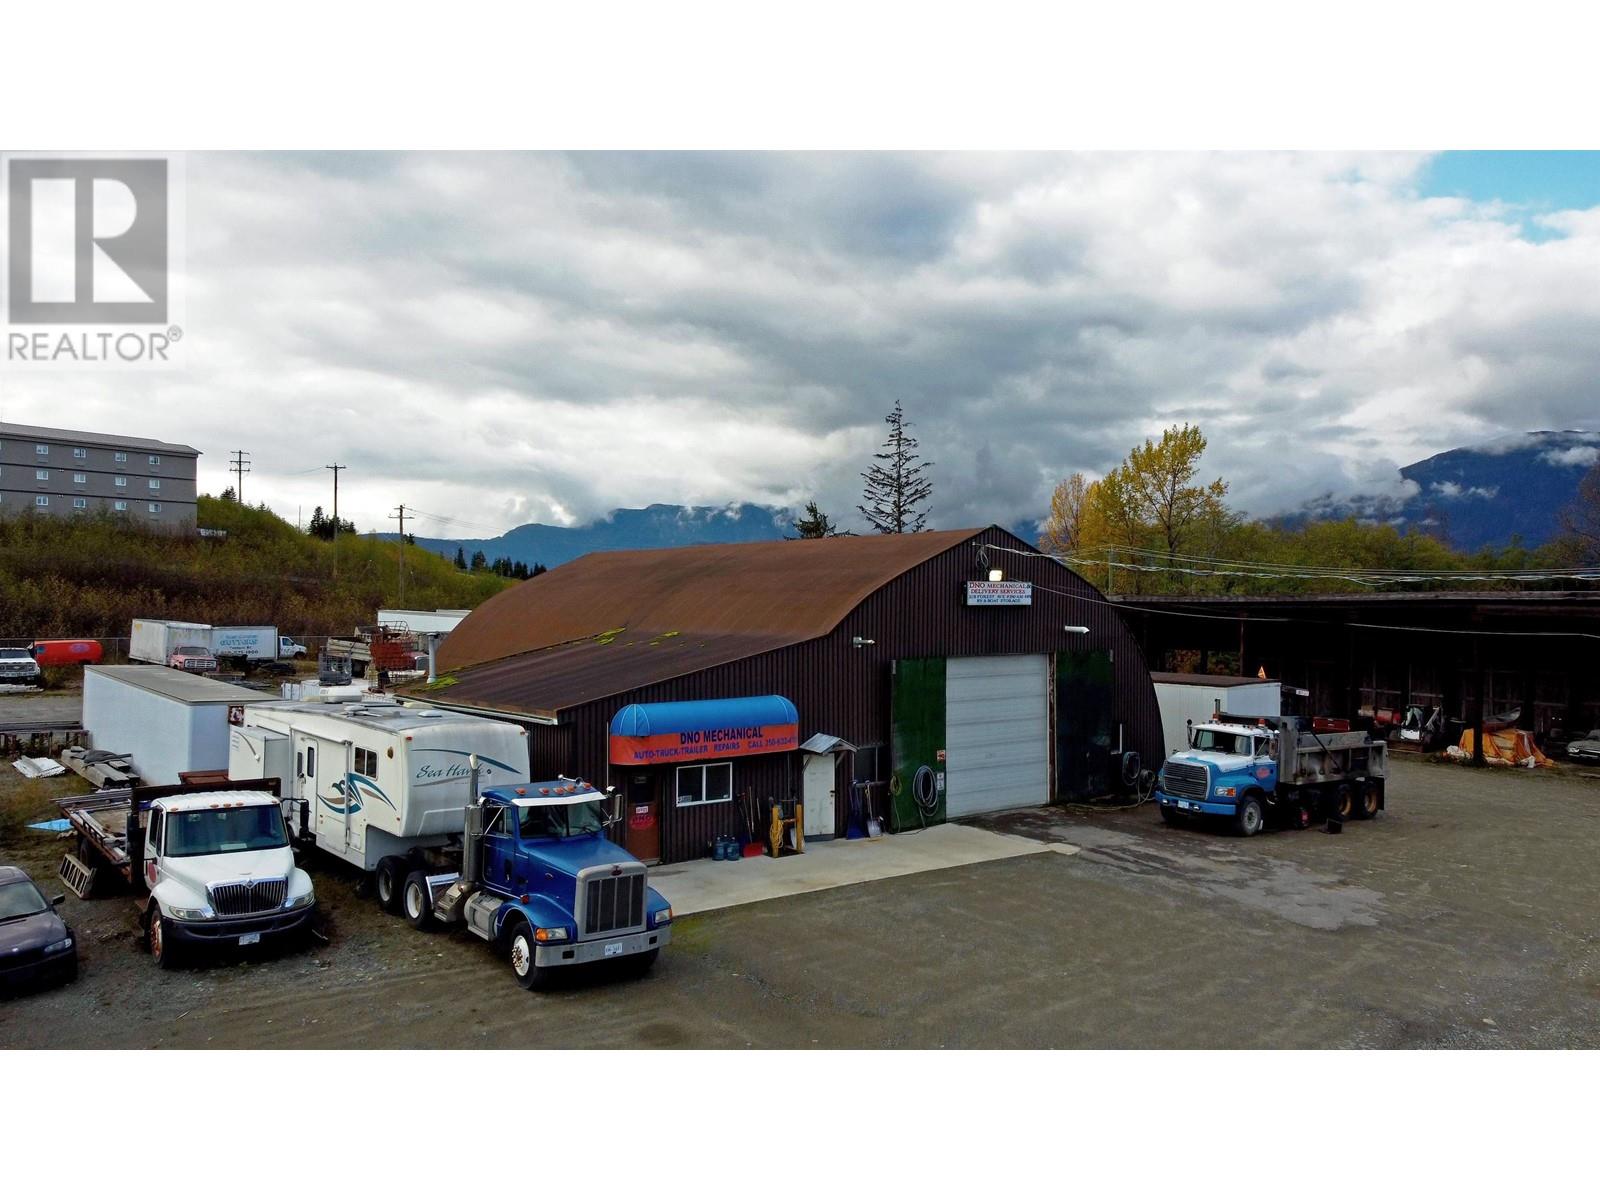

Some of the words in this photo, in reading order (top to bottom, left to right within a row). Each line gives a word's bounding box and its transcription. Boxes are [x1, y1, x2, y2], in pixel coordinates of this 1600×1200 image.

[680, 730, 700, 744] DNO
[703, 726, 763, 742] MECHANICAL
[713, 742, 740, 752] REPAIRS
[416, 765, 442, 779] Sea
